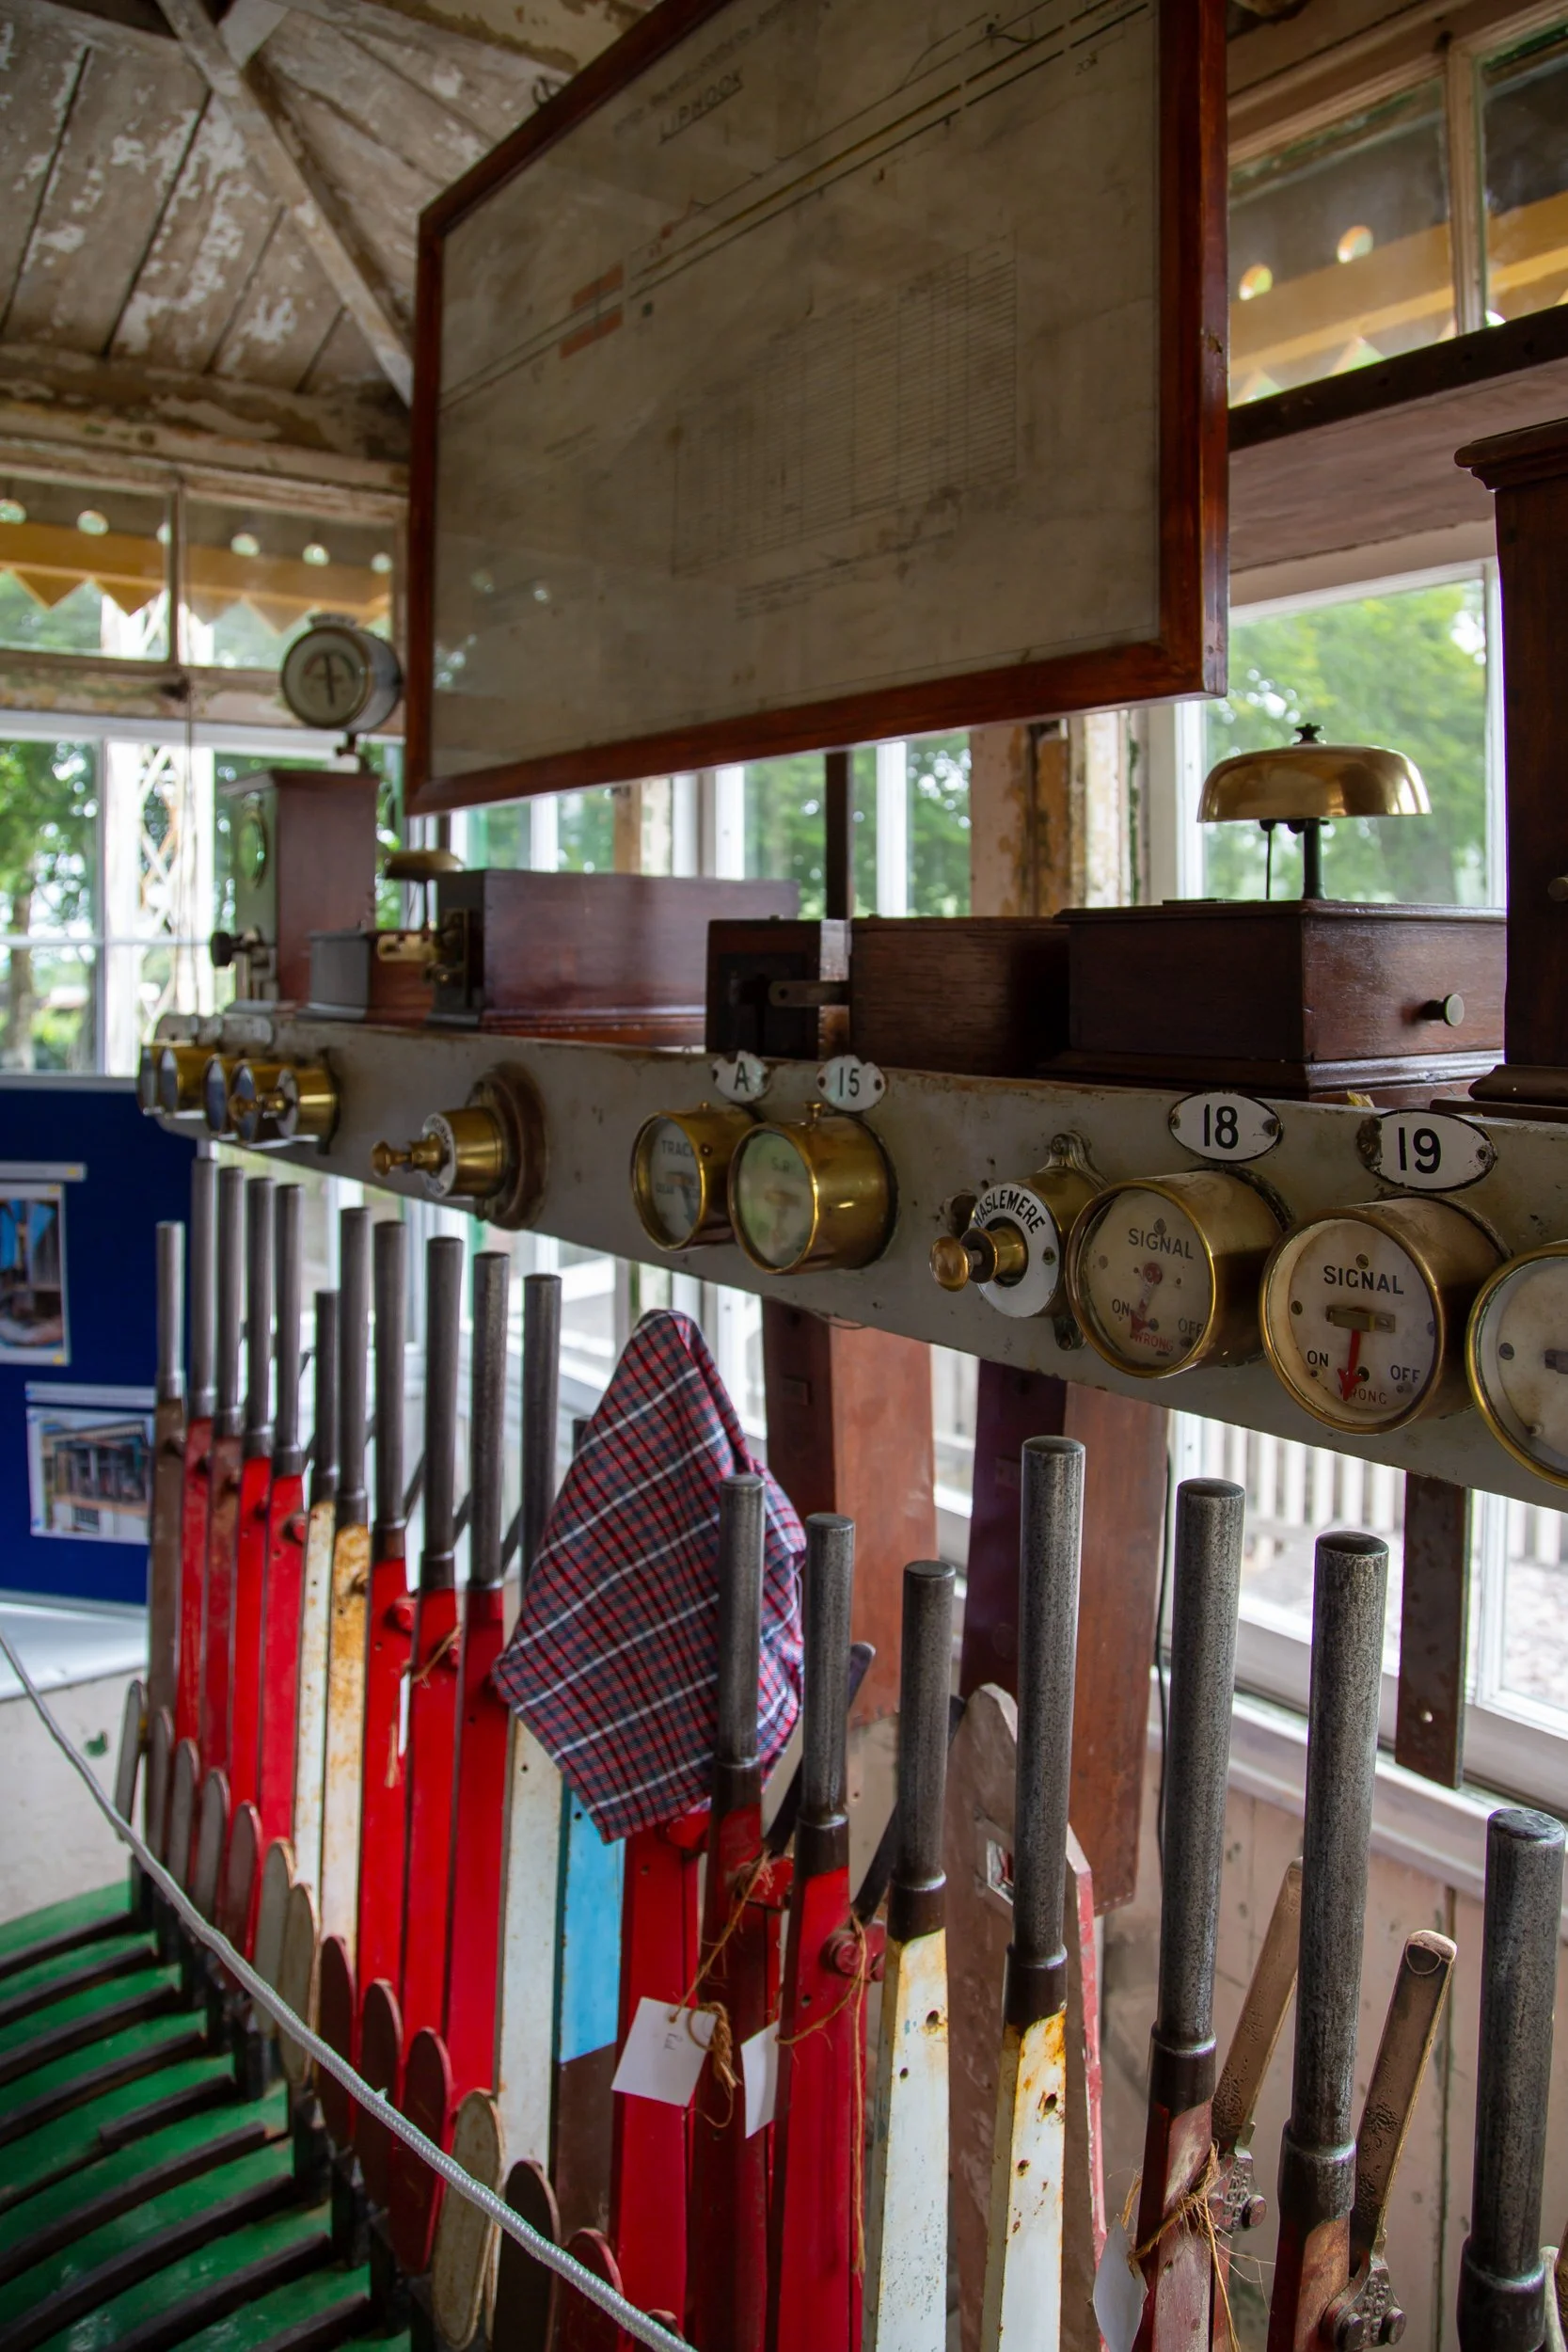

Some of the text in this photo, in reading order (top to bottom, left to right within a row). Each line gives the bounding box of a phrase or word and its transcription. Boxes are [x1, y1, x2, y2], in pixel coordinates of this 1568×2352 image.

[734, 1061, 750, 1092] A
[839, 1067, 860, 1098] 15
[1204, 1104, 1240, 1150] 18
[1398, 1126, 1442, 1173] 19
[974, 1189, 1046, 1234] HASLEMERE
[1128, 1227, 1195, 1260] SIGNAL
[1323, 1264, 1404, 1295] SIGNAL
[1112, 1298, 1131, 1317] ON
[1178, 1318, 1204, 1338] OFF
[1307, 1350, 1329, 1367] ON
[1390, 1364, 1421, 1383] OFF
